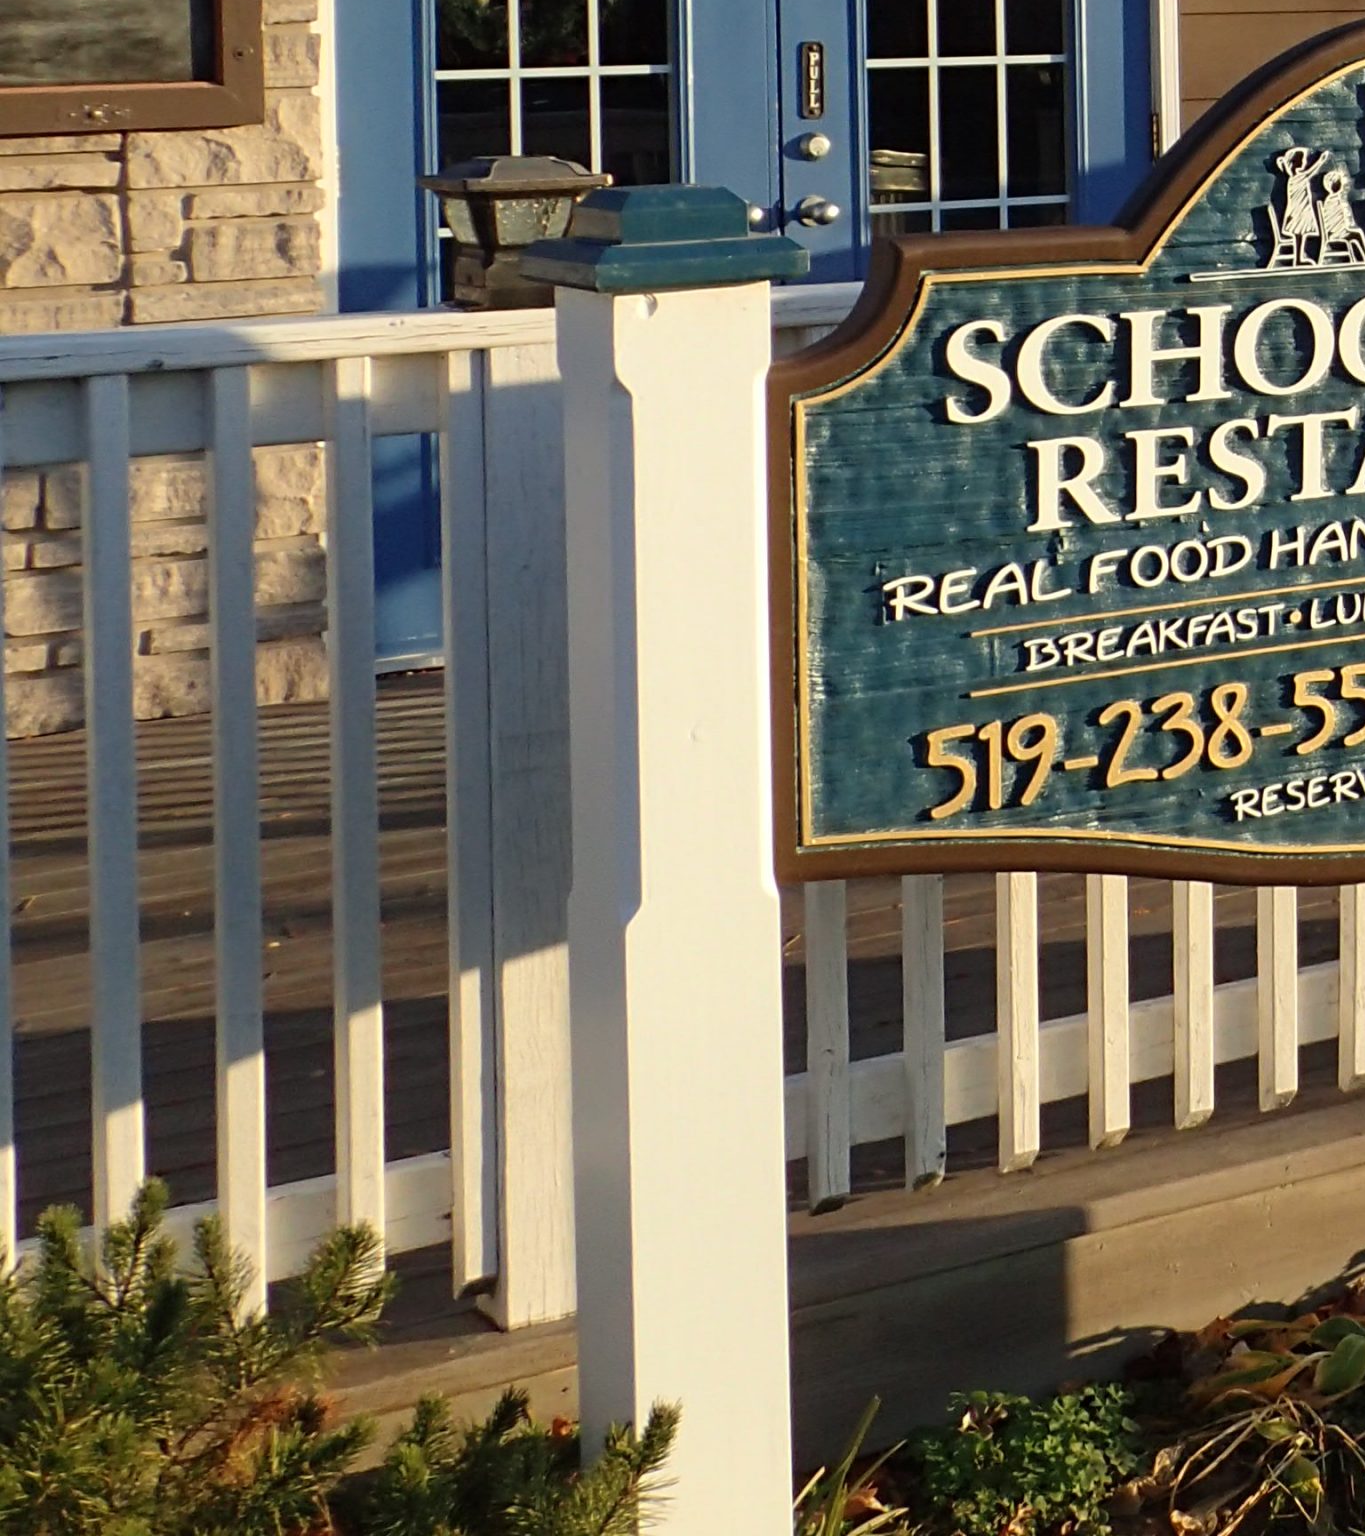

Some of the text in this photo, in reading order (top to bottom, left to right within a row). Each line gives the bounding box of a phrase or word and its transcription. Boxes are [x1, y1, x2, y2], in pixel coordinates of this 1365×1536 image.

[808, 52, 820, 108] PULL
[883, 559, 1072, 621] REAL
[1089, 536, 1252, 593] FOOD
[1023, 603, 1286, 672] BREAKFAST
